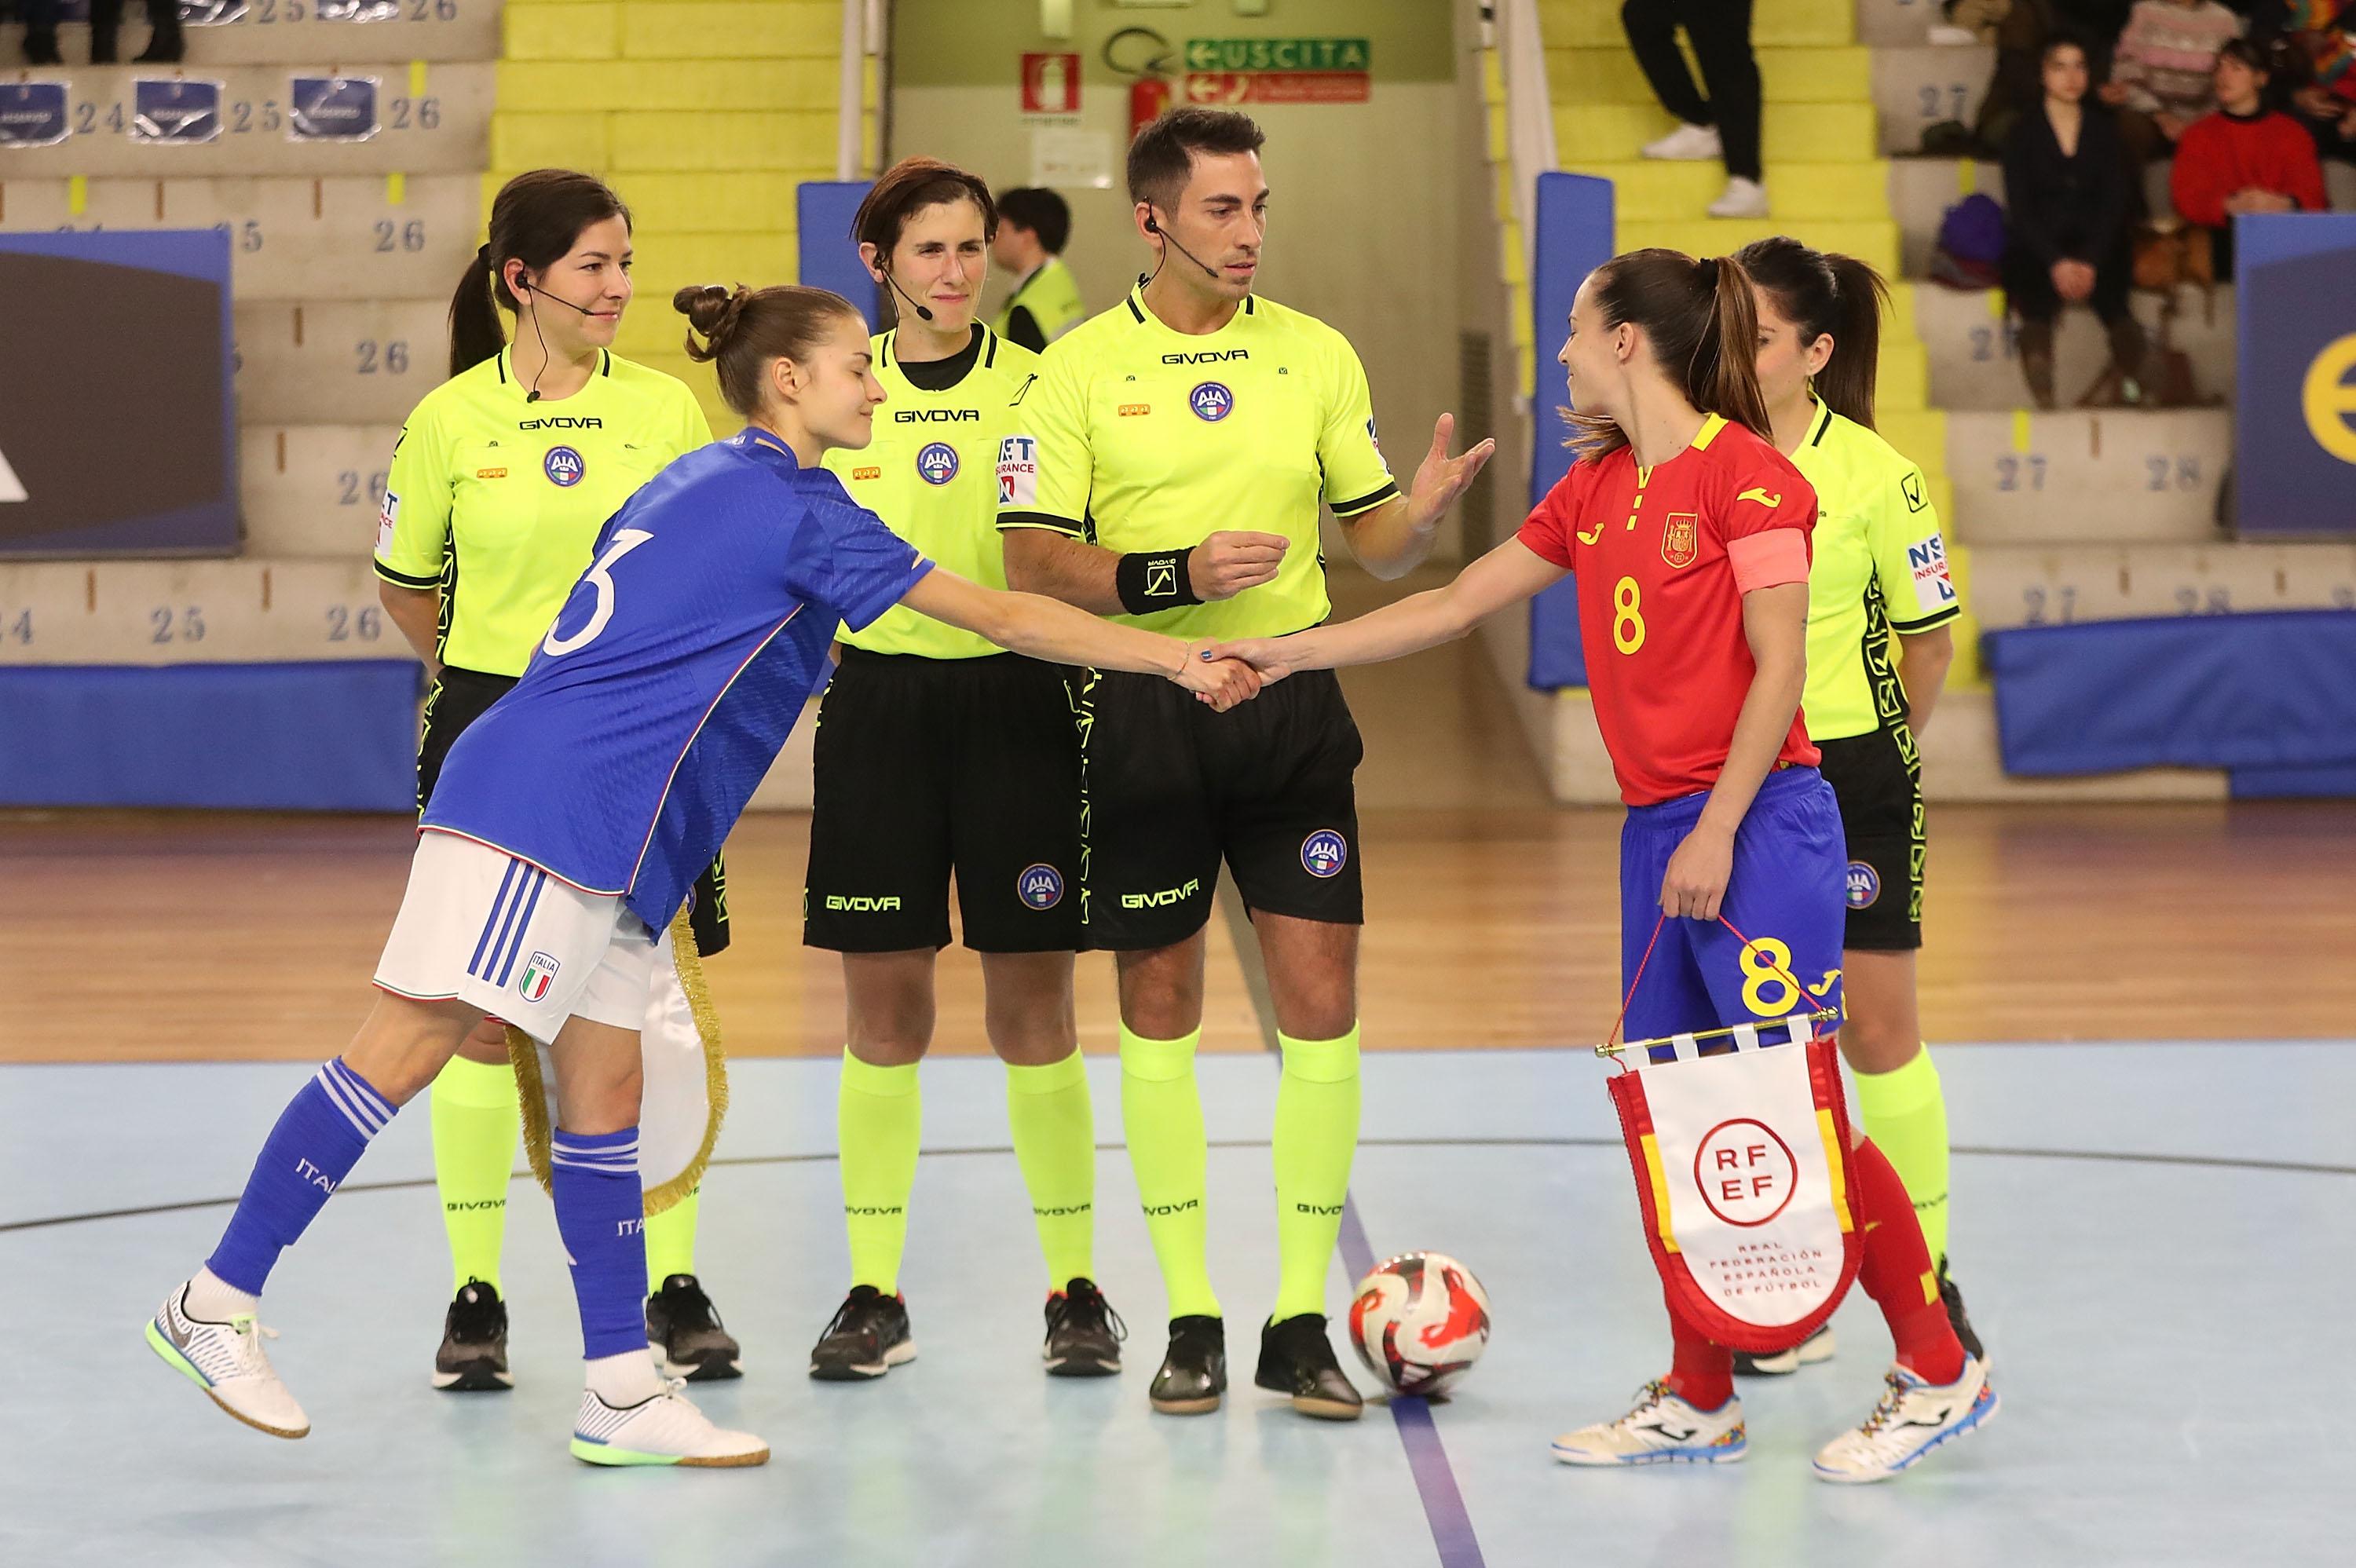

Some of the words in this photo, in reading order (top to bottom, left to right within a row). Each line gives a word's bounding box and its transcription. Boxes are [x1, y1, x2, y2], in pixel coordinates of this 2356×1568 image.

[1228, 43, 1364, 68] USCITA
[76, 101, 124, 134] 24
[232, 100, 281, 133] 25
[392, 97, 441, 130] 26
[375, 221, 426, 253] 26
[357, 340, 409, 374] 26
[1162, 349, 1249, 365] GIVOVA
[1197, 390, 1227, 407] AIA
[519, 418, 602, 430] GIVOVA
[894, 410, 979, 423] GIVOVA
[924, 452, 953, 469] AIA
[998, 438, 1034, 462] ET
[551, 455, 579, 472] AIA
[1908, 534, 1942, 568] NE
[543, 528, 654, 656] 3
[151, 606, 206, 644] 25
[327, 605, 382, 642] 26
[1613, 576, 1646, 656] 8
[1308, 842, 1339, 861] AIA
[1027, 875, 1055, 894] AIA
[1122, 878, 1200, 909] GIVOVA
[826, 895, 901, 912] GIVOVA
[532, 955, 555, 973] ITALIA
[1739, 937, 1801, 1018] 8
[295, 1157, 338, 1194] ITAL
[1297, 1203, 1344, 1215] GIVO
[617, 1218, 645, 1237] ITA
[1738, 1242, 1783, 1254] REAL
[1710, 1249, 1822, 1270] FEDERACIÓN
[1724, 1266, 1815, 1282] ESPAÑOLA
[1724, 1287, 1743, 1296] DE
[1754, 1281, 1820, 1293] FÚTBOL
